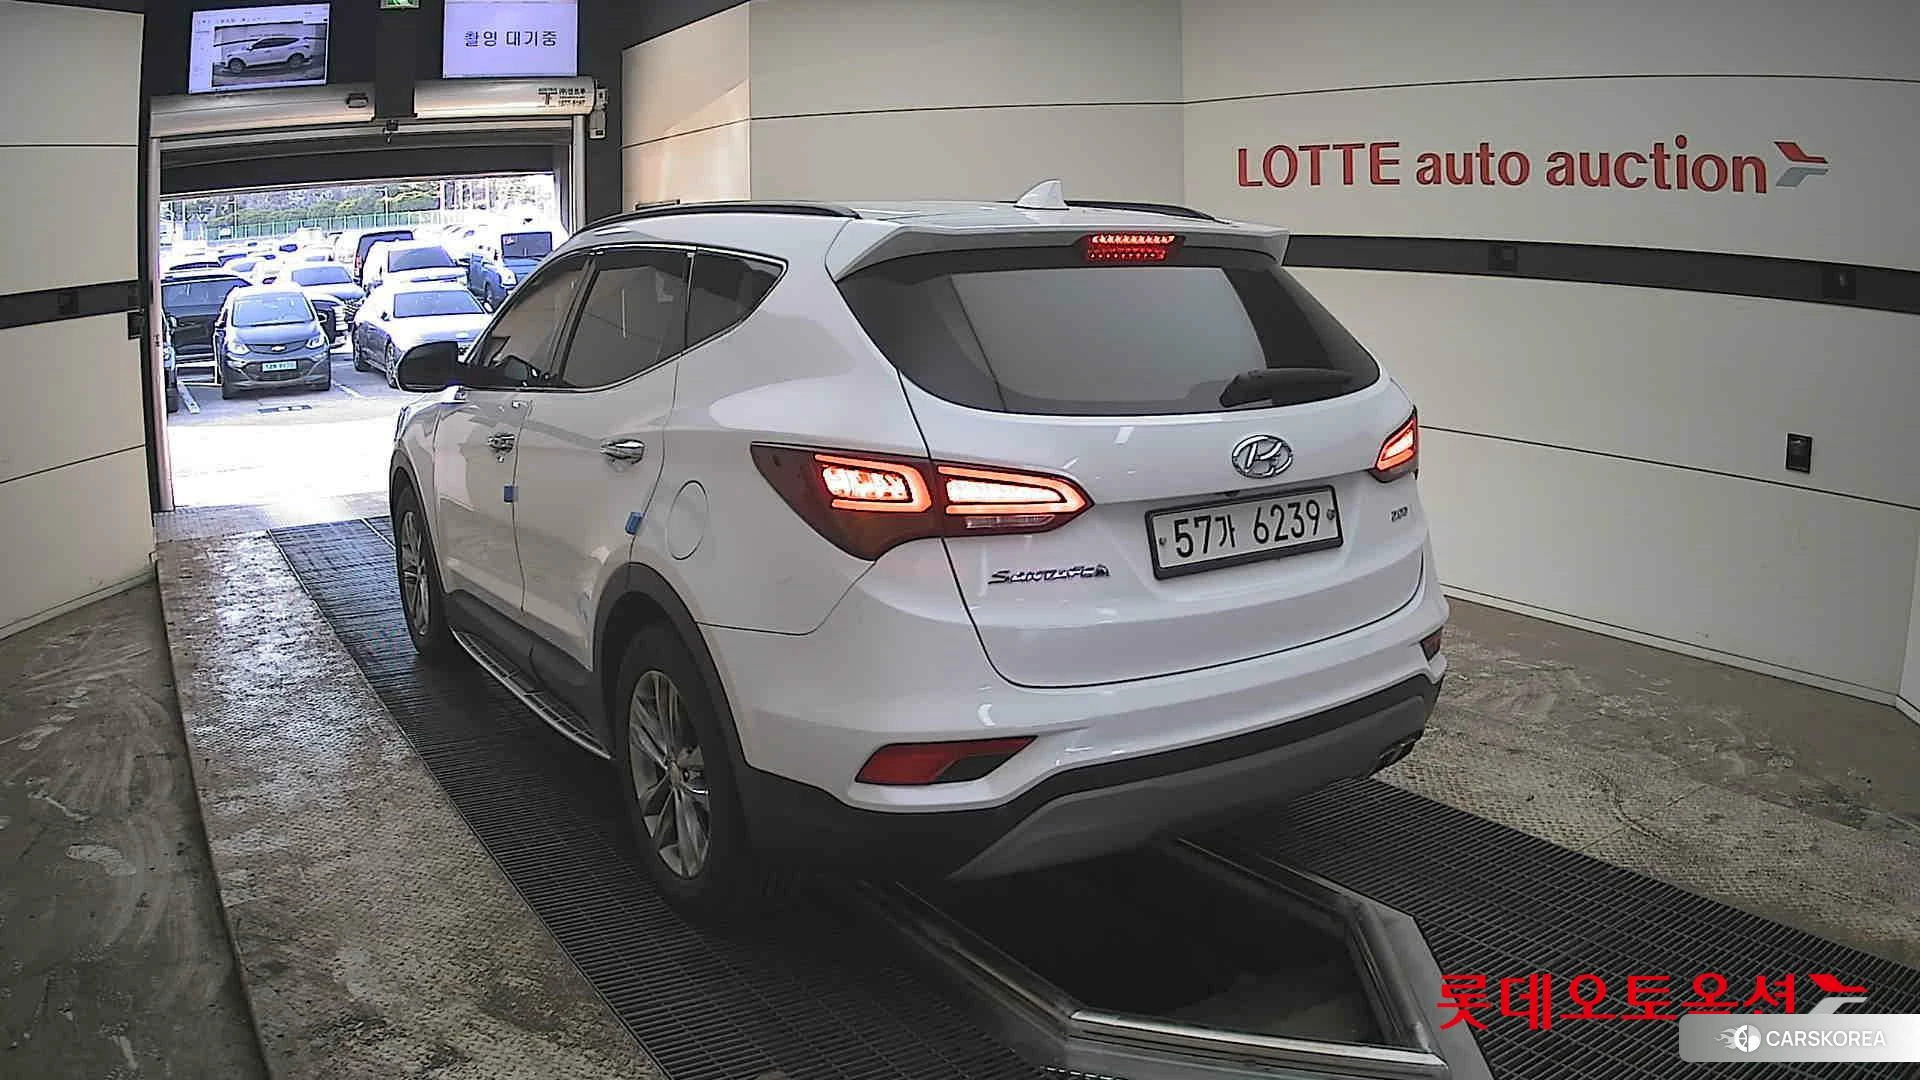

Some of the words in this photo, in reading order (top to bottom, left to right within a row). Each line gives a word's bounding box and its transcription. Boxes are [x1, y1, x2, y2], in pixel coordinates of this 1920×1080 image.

[506, 30, 558, 47] 대기중
[1238, 141, 1401, 188] LOTTE
[1416, 142, 1530, 188] auto
[1546, 135, 1768, 195] auction
[1173, 514, 1236, 559] 57가
[1253, 499, 1322, 545] 6239
